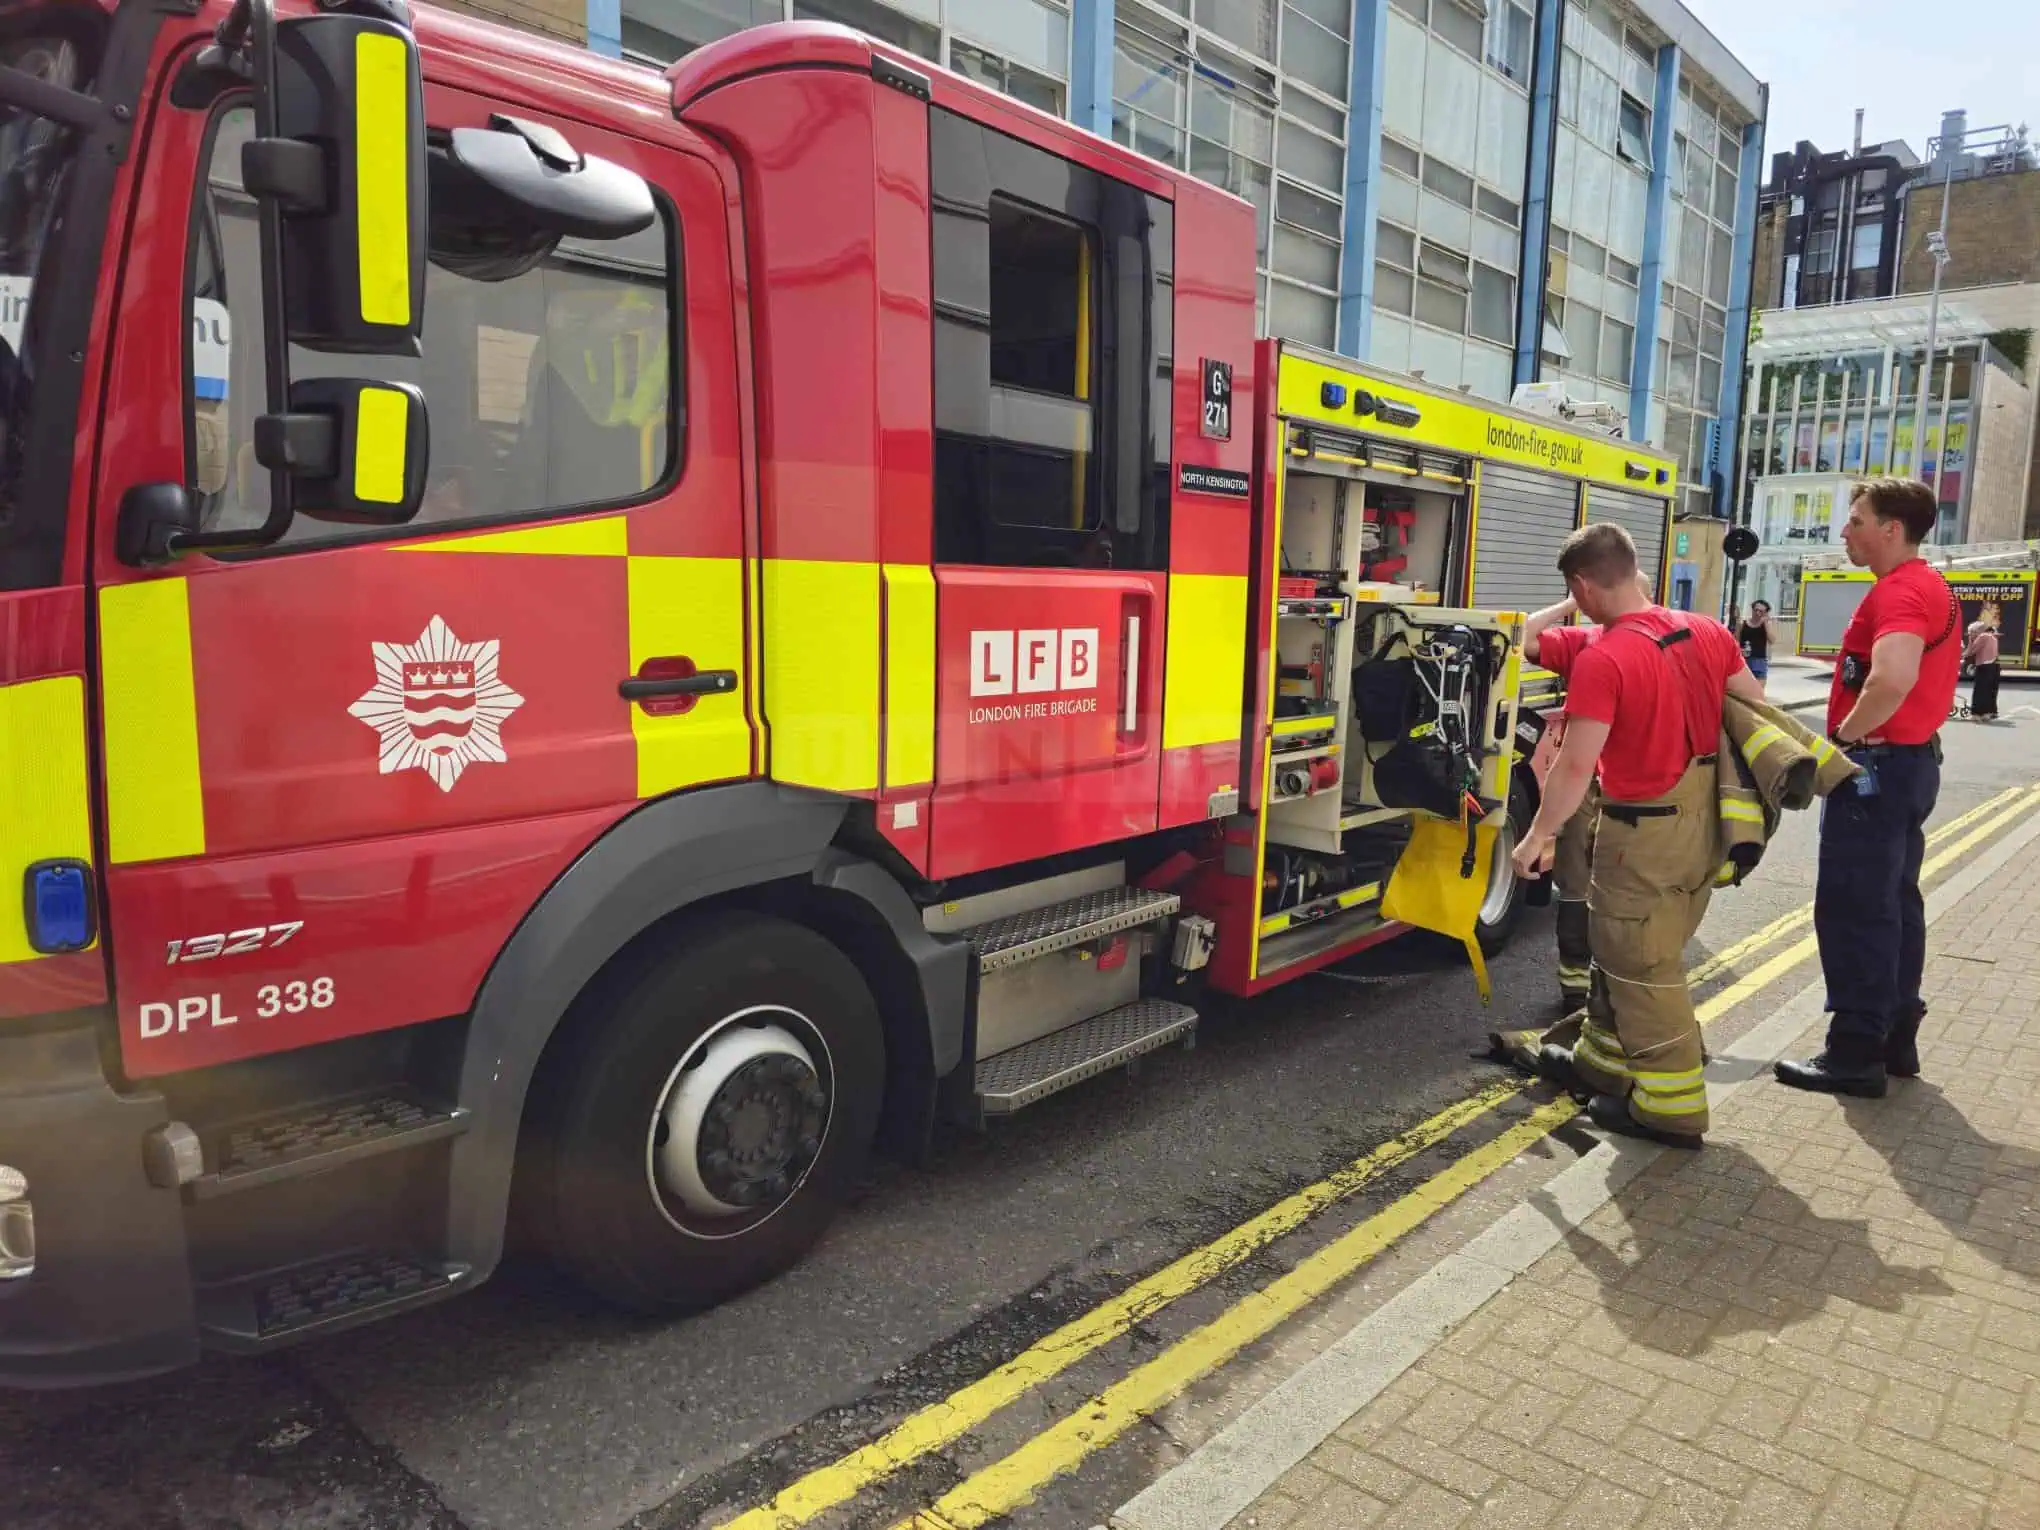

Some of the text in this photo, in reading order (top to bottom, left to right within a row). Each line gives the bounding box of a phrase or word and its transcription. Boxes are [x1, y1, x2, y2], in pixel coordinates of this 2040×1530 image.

[1212, 370, 1222, 396] G
[1205, 401, 1229, 430] 271
[1487, 416, 1584, 466] london-fire.gov.uk
[1180, 471, 1249, 492] NORTH KENSINGTON
[1954, 592, 2024, 601] TURN IT OFF
[980, 637, 1092, 685] LFB
[969, 698, 1097, 724] LONDON FIRE BRIGADE
[166, 920, 305, 966] 1327
[140, 976, 335, 1040] DPL 338
